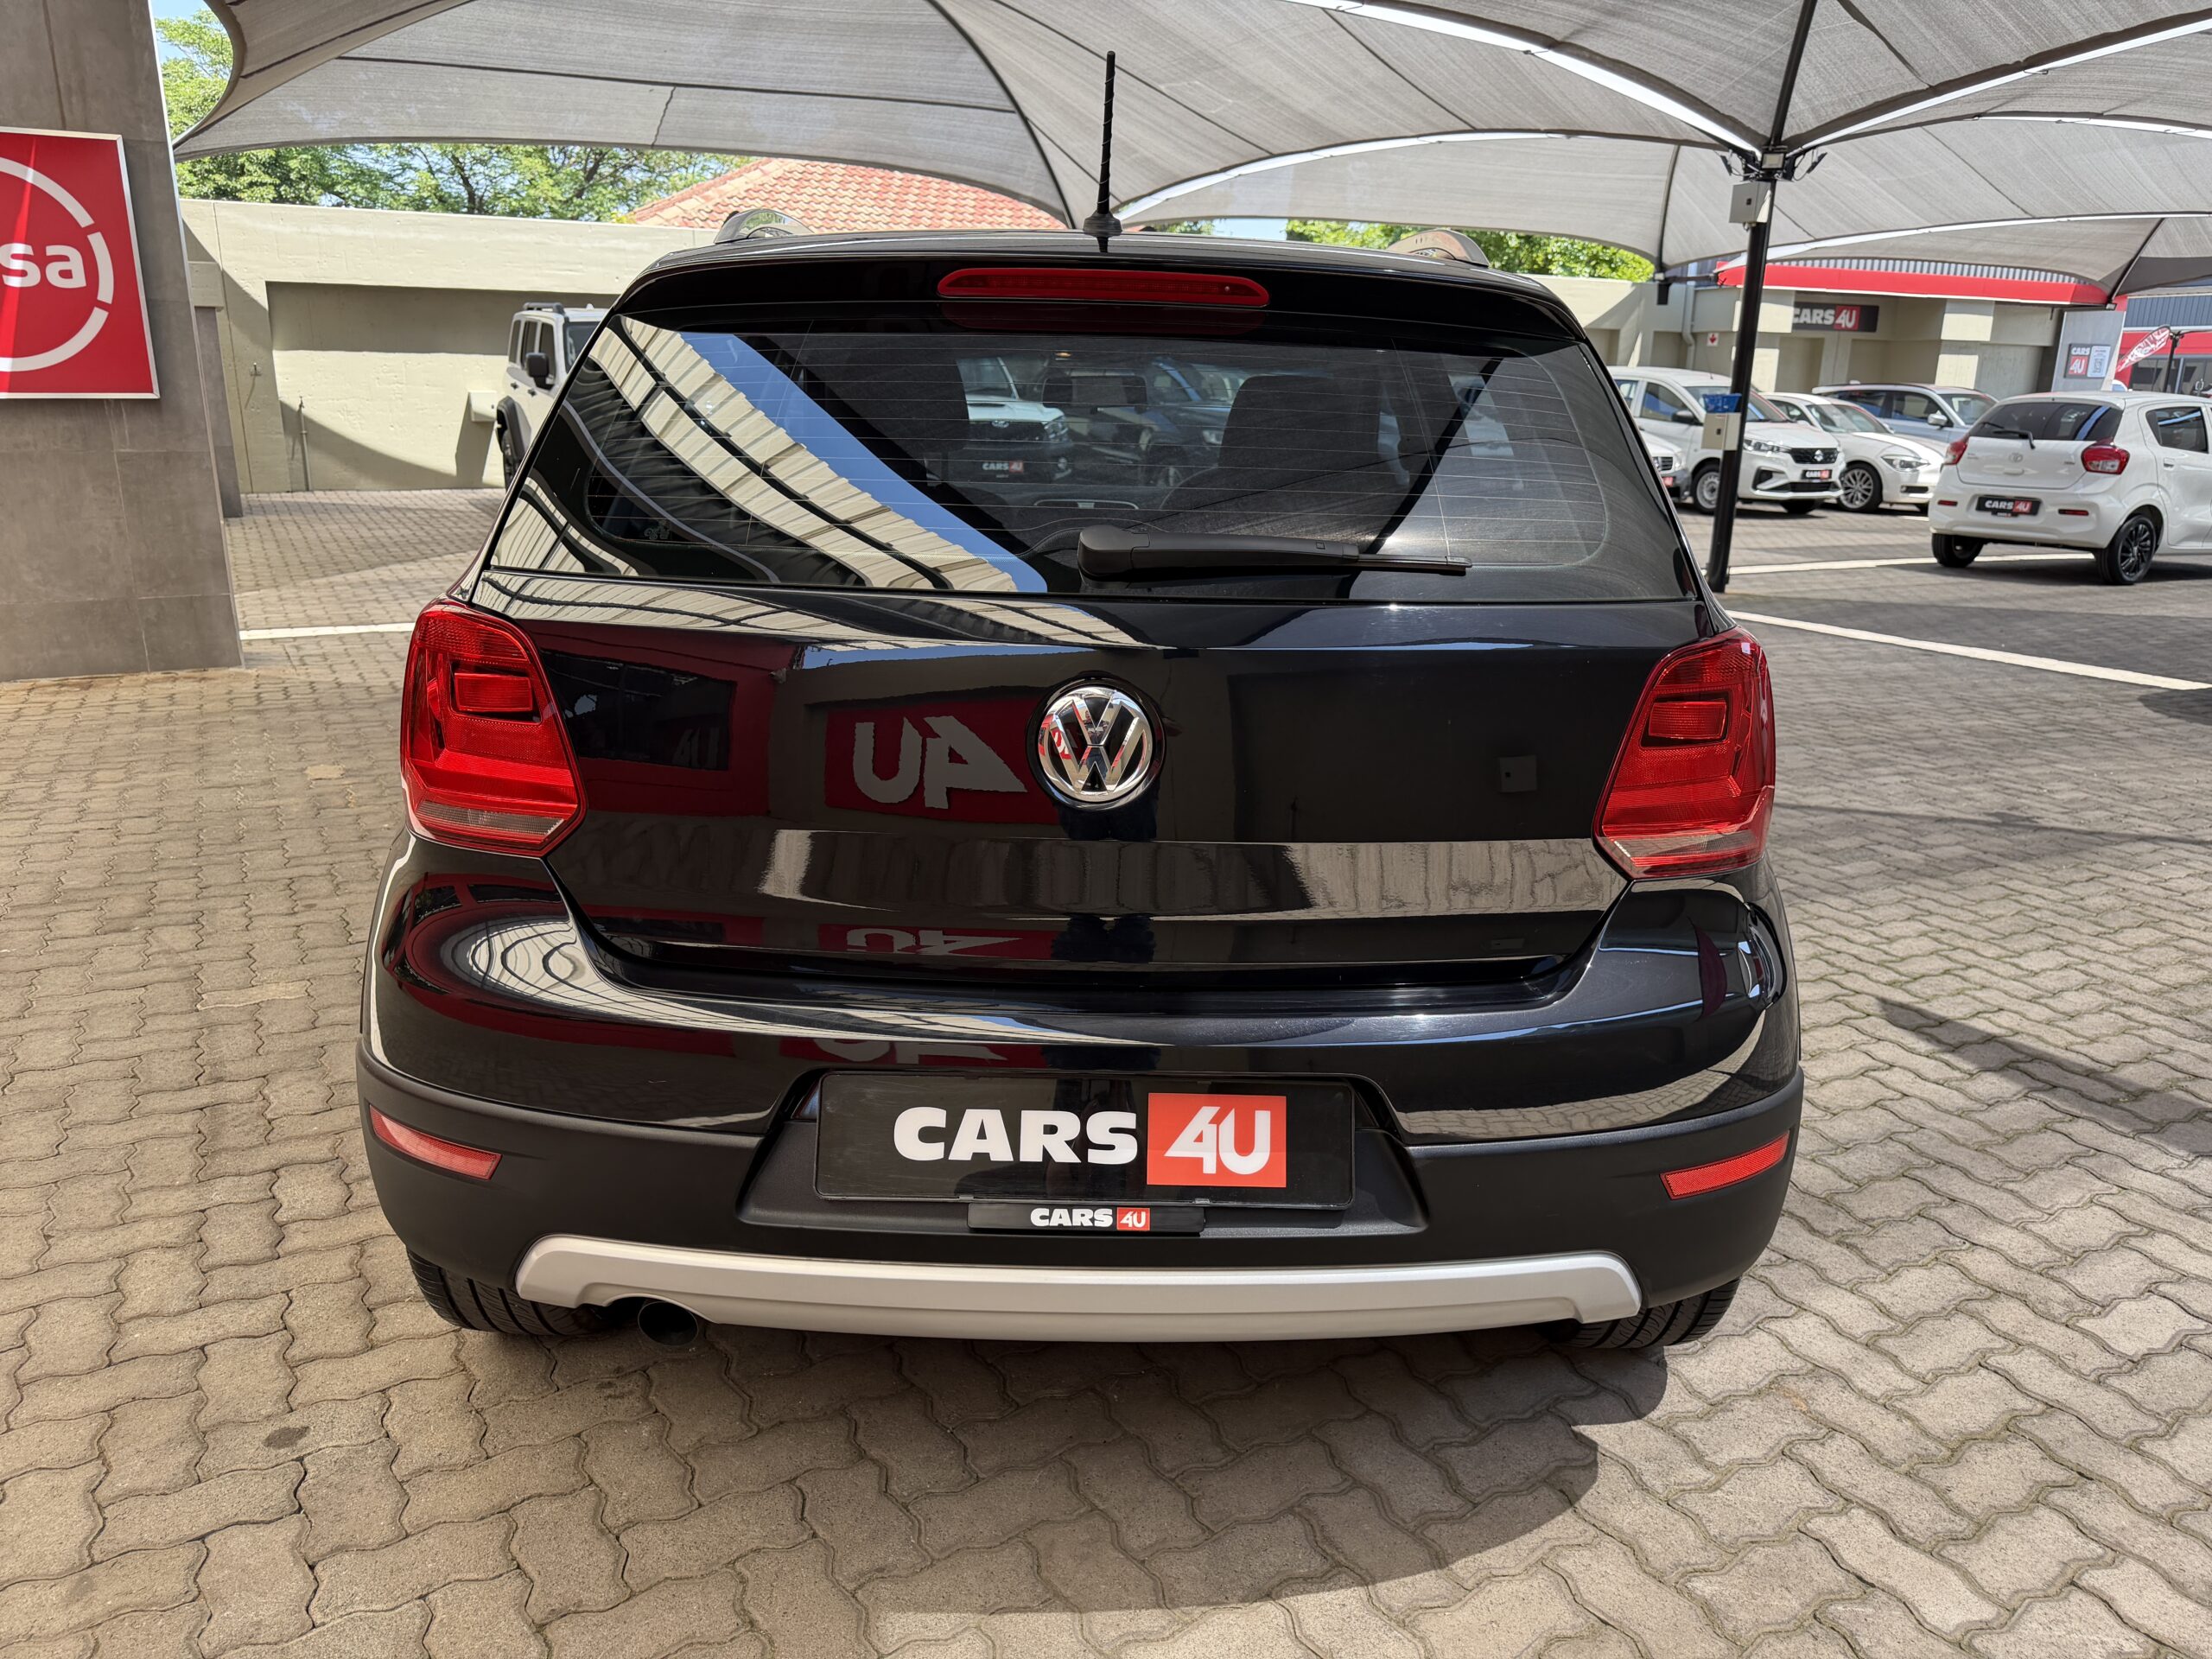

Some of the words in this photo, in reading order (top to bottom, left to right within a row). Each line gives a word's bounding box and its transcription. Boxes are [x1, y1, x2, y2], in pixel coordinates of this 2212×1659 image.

[1985, 499, 2014, 510] CARS
[893, 1106, 1138, 1165] CARS
[1164, 1106, 1271, 1175] 4U
[1030, 1207, 1113, 1228] CARS
[1120, 1211, 1147, 1228] 4U
